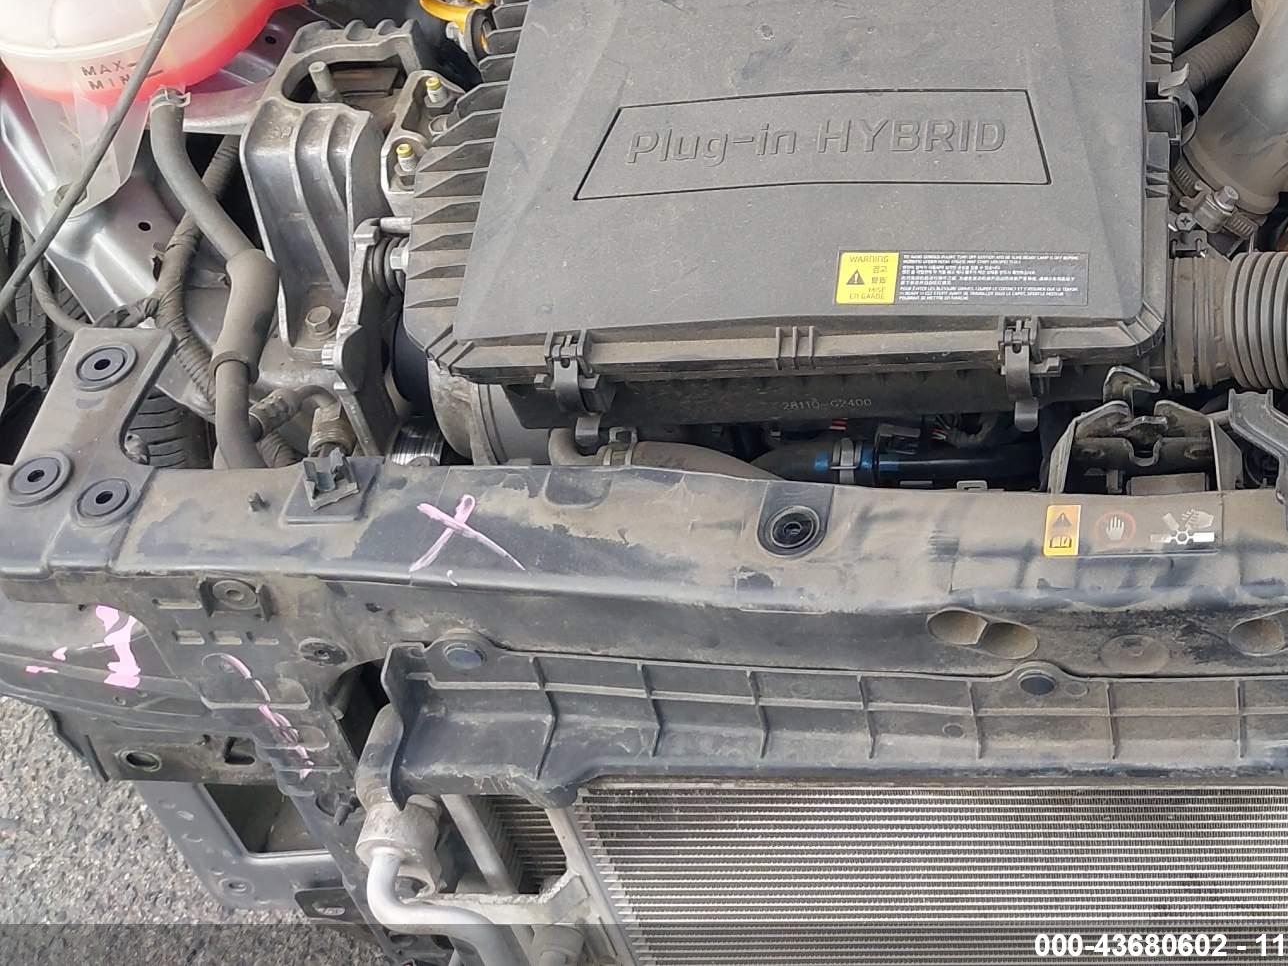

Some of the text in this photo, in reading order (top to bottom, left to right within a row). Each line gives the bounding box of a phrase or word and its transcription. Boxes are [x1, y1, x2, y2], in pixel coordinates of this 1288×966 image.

[81, 60, 125, 76] MAX
[627, 117, 1007, 168] Plug-in HYBRID
[849, 255, 889, 263] WARNING
